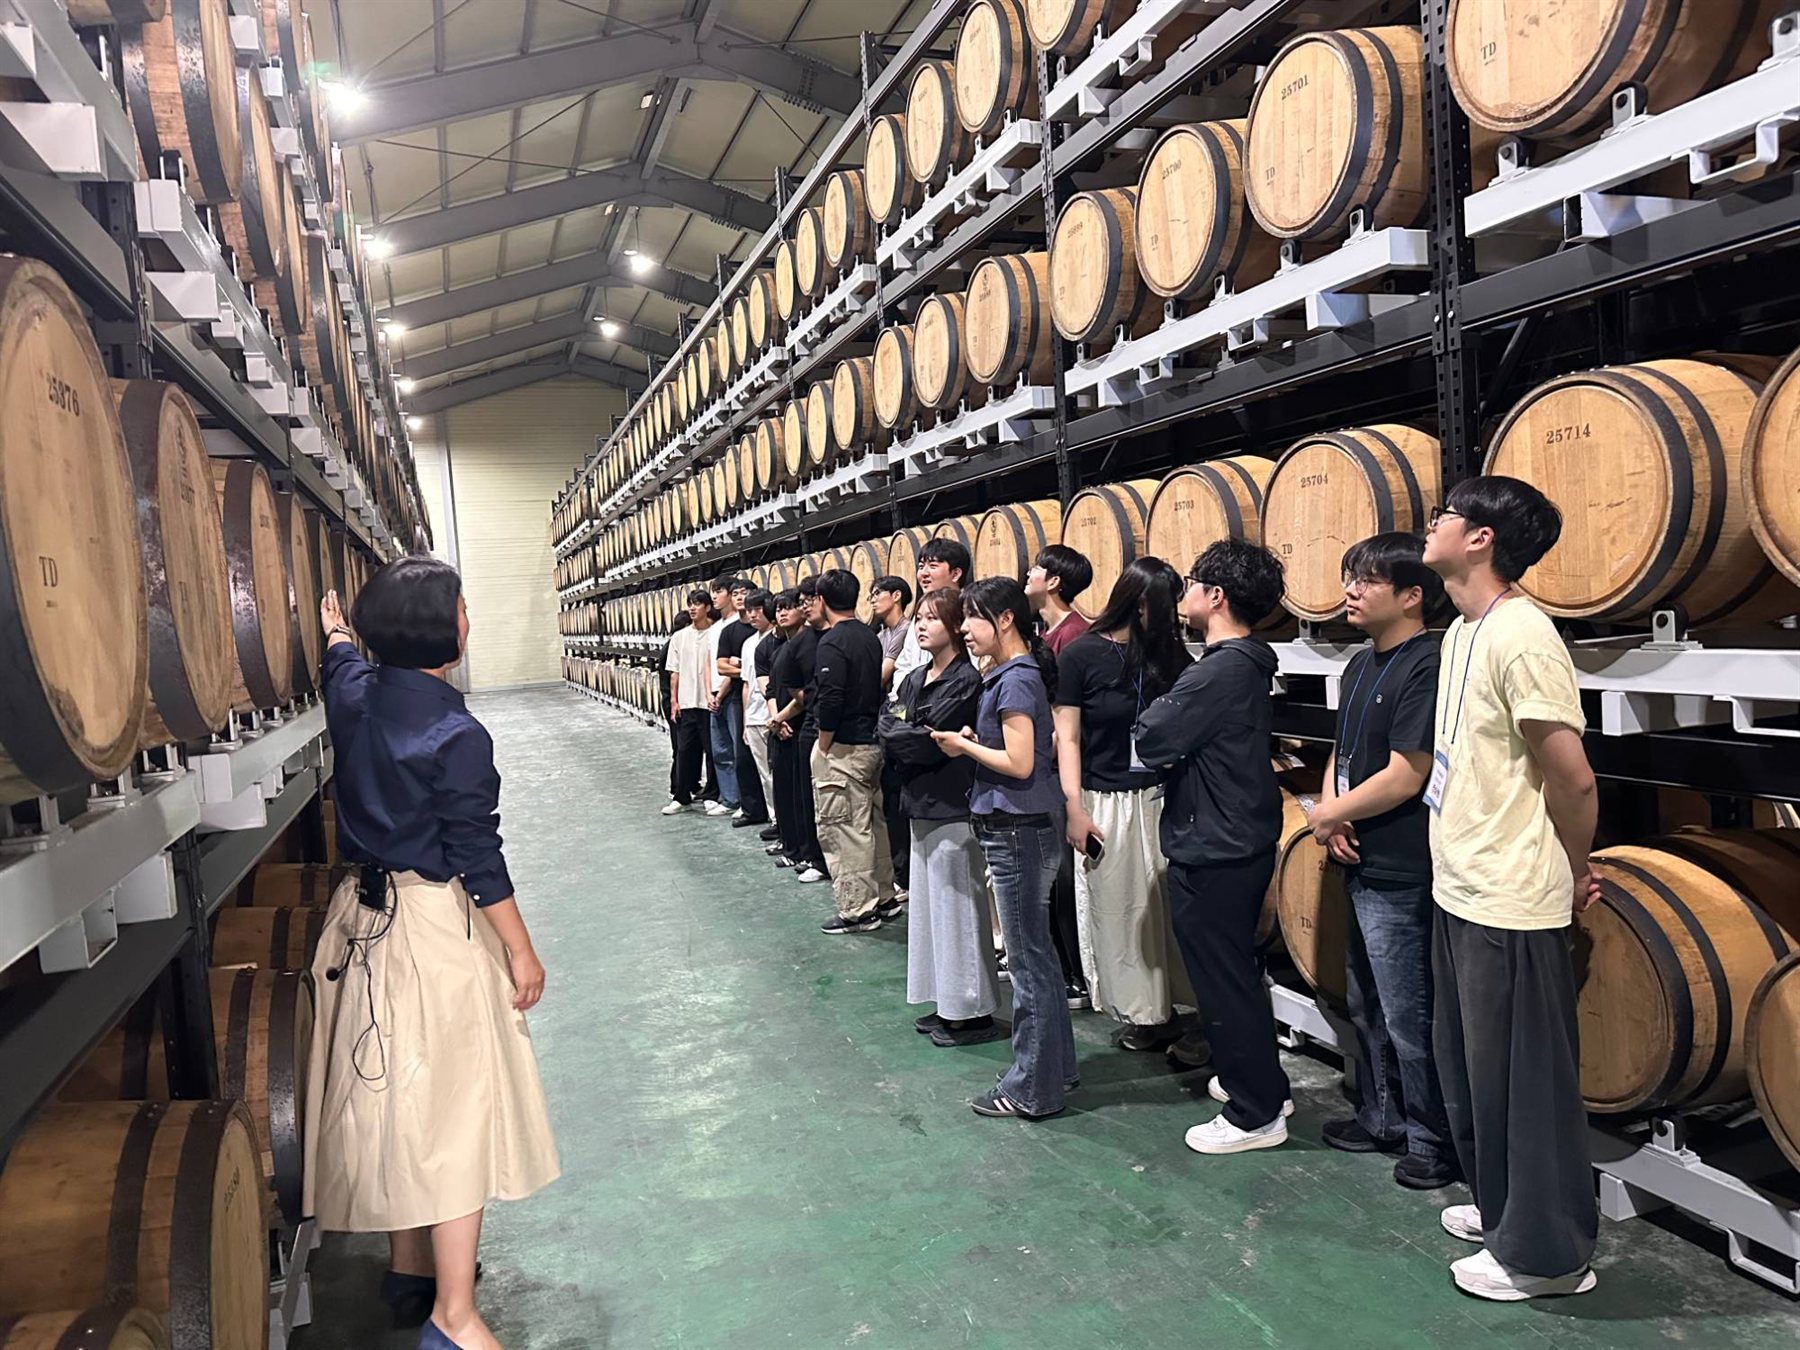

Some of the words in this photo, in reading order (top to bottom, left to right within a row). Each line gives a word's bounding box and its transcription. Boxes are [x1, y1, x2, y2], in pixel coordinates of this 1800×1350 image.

[1480, 41, 1497, 60] TD
[1281, 73, 1309, 100] 25701
[1265, 166, 1276, 181] TD
[1546, 423, 1591, 444] 25714
[1300, 473, 1328, 489] 25704
[1281, 543, 1293, 554] TD
[39, 556, 58, 588] TD
[1300, 916, 1312, 929] TD
